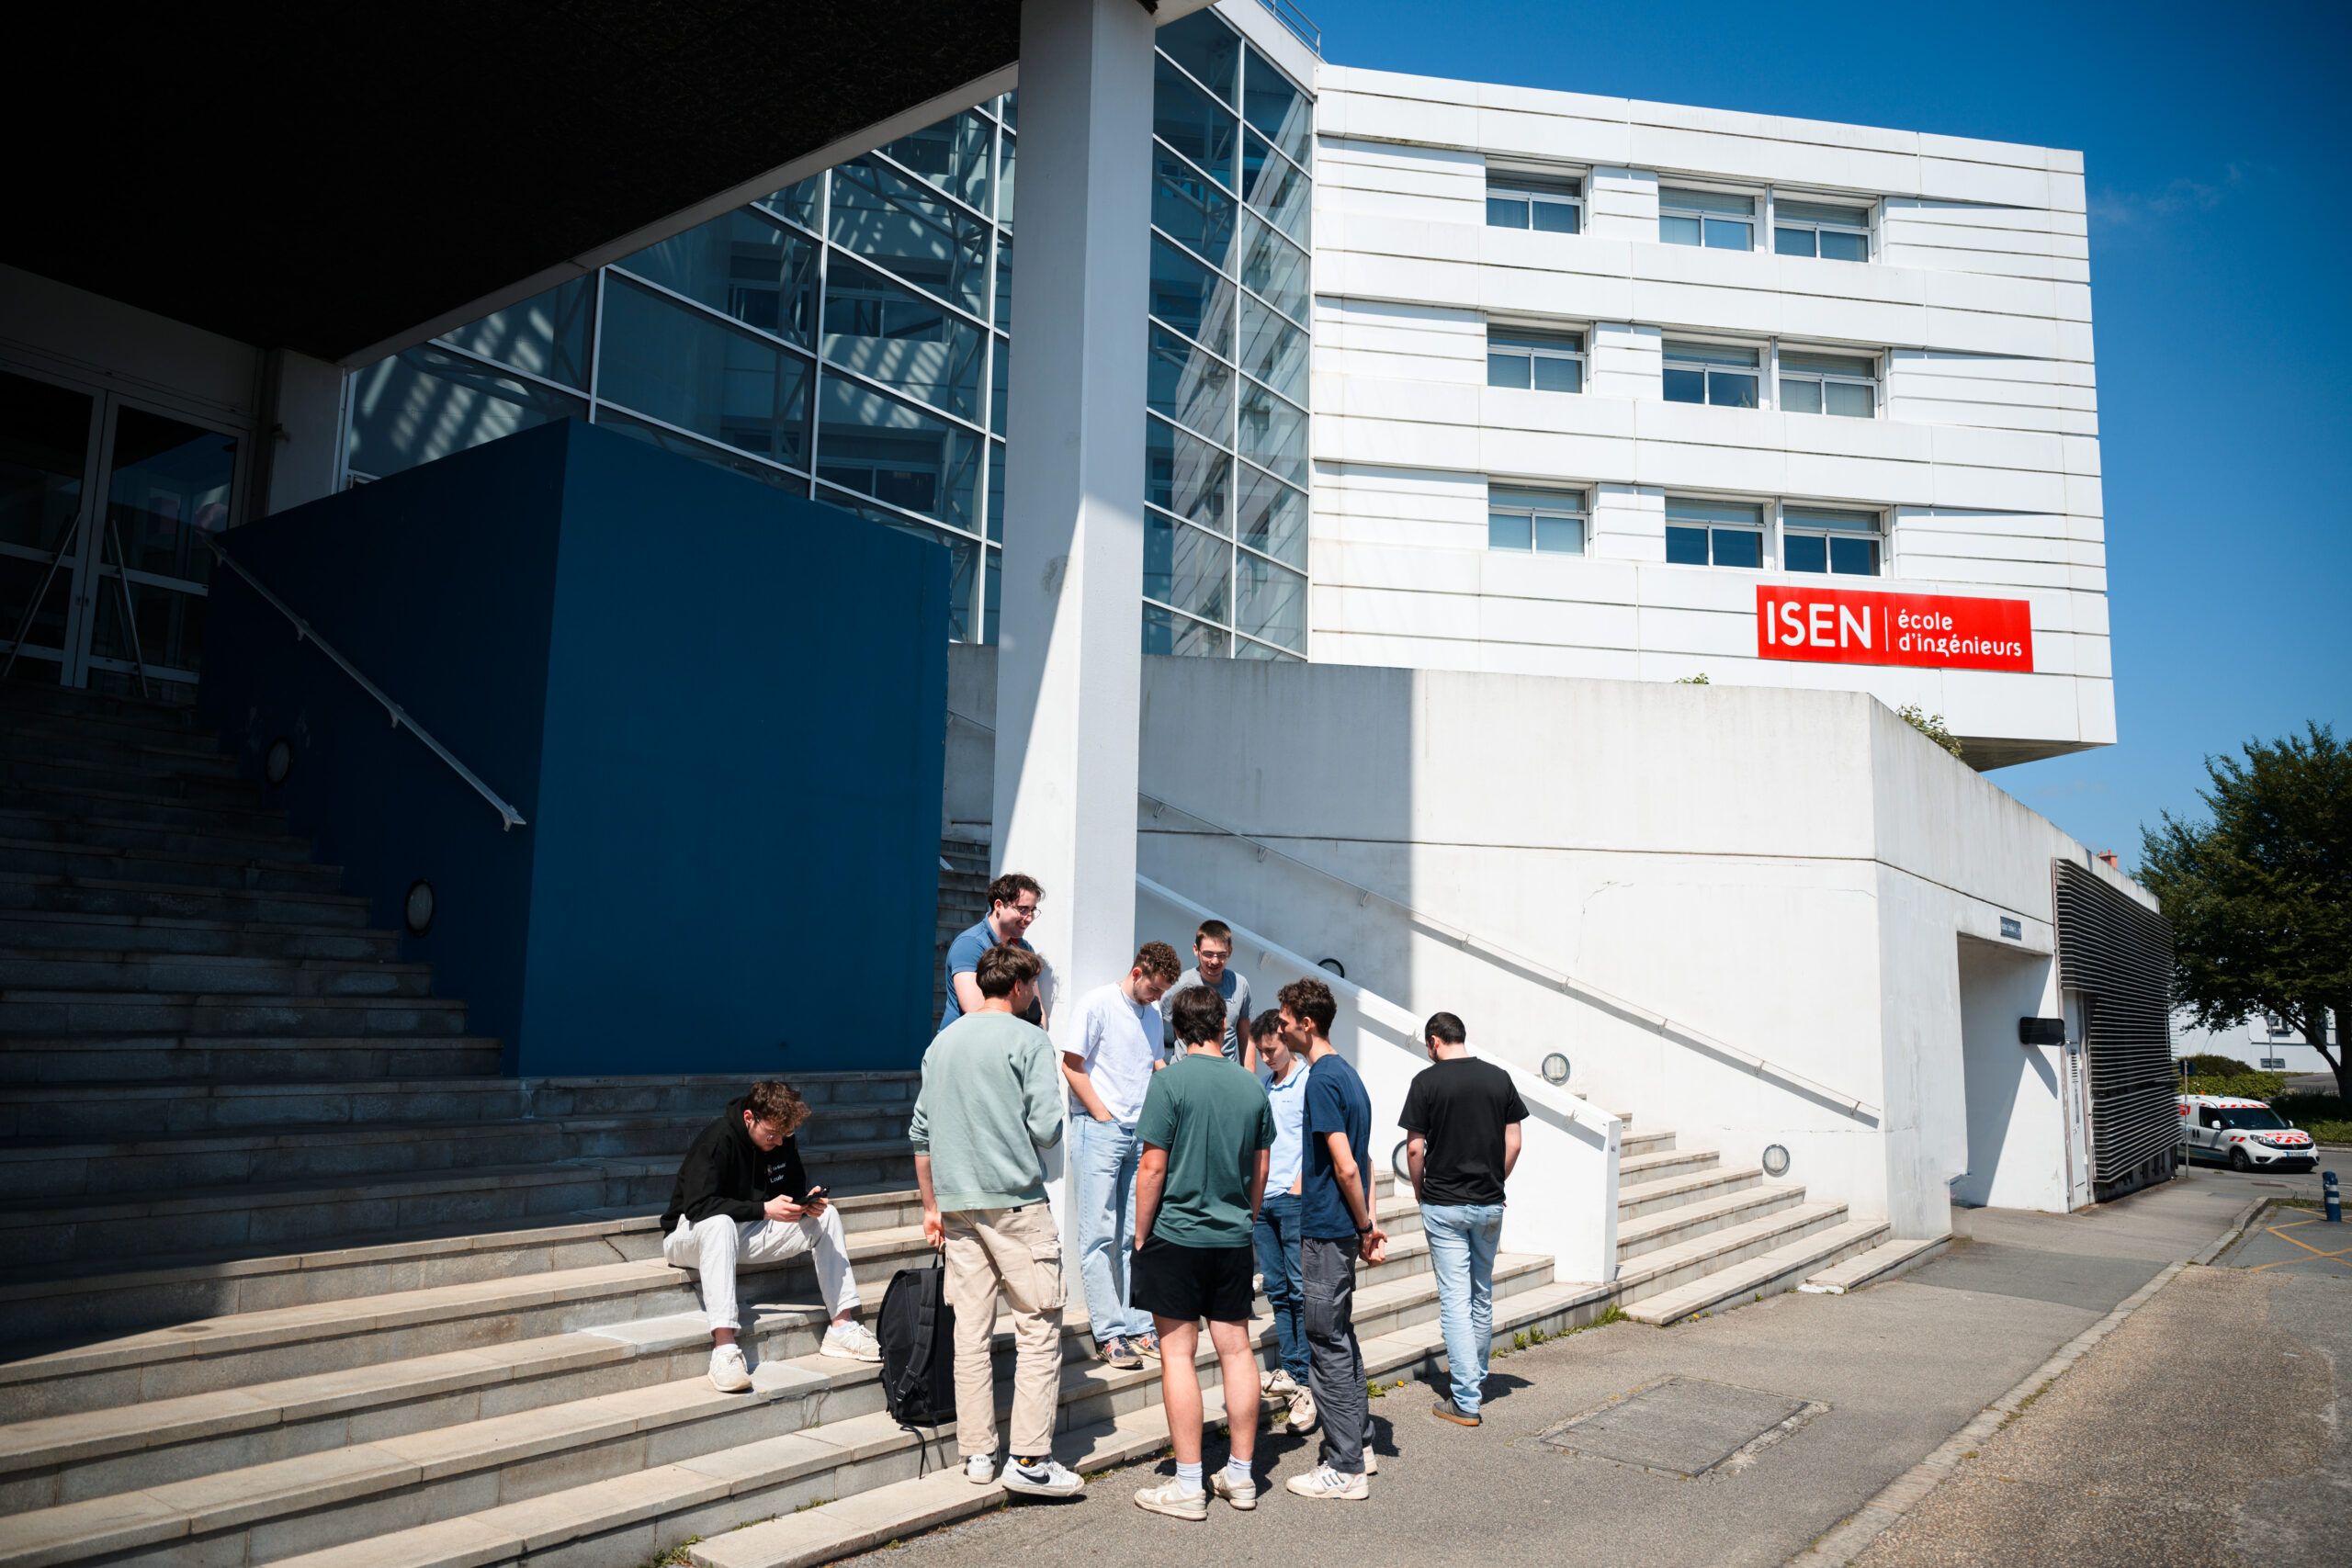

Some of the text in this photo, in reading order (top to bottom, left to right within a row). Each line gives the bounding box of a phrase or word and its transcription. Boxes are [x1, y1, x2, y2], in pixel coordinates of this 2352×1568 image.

[1767, 601, 1871, 649] ISEN
[1897, 608, 1953, 631] école
[1898, 633, 2022, 658] d'ingénieurs
